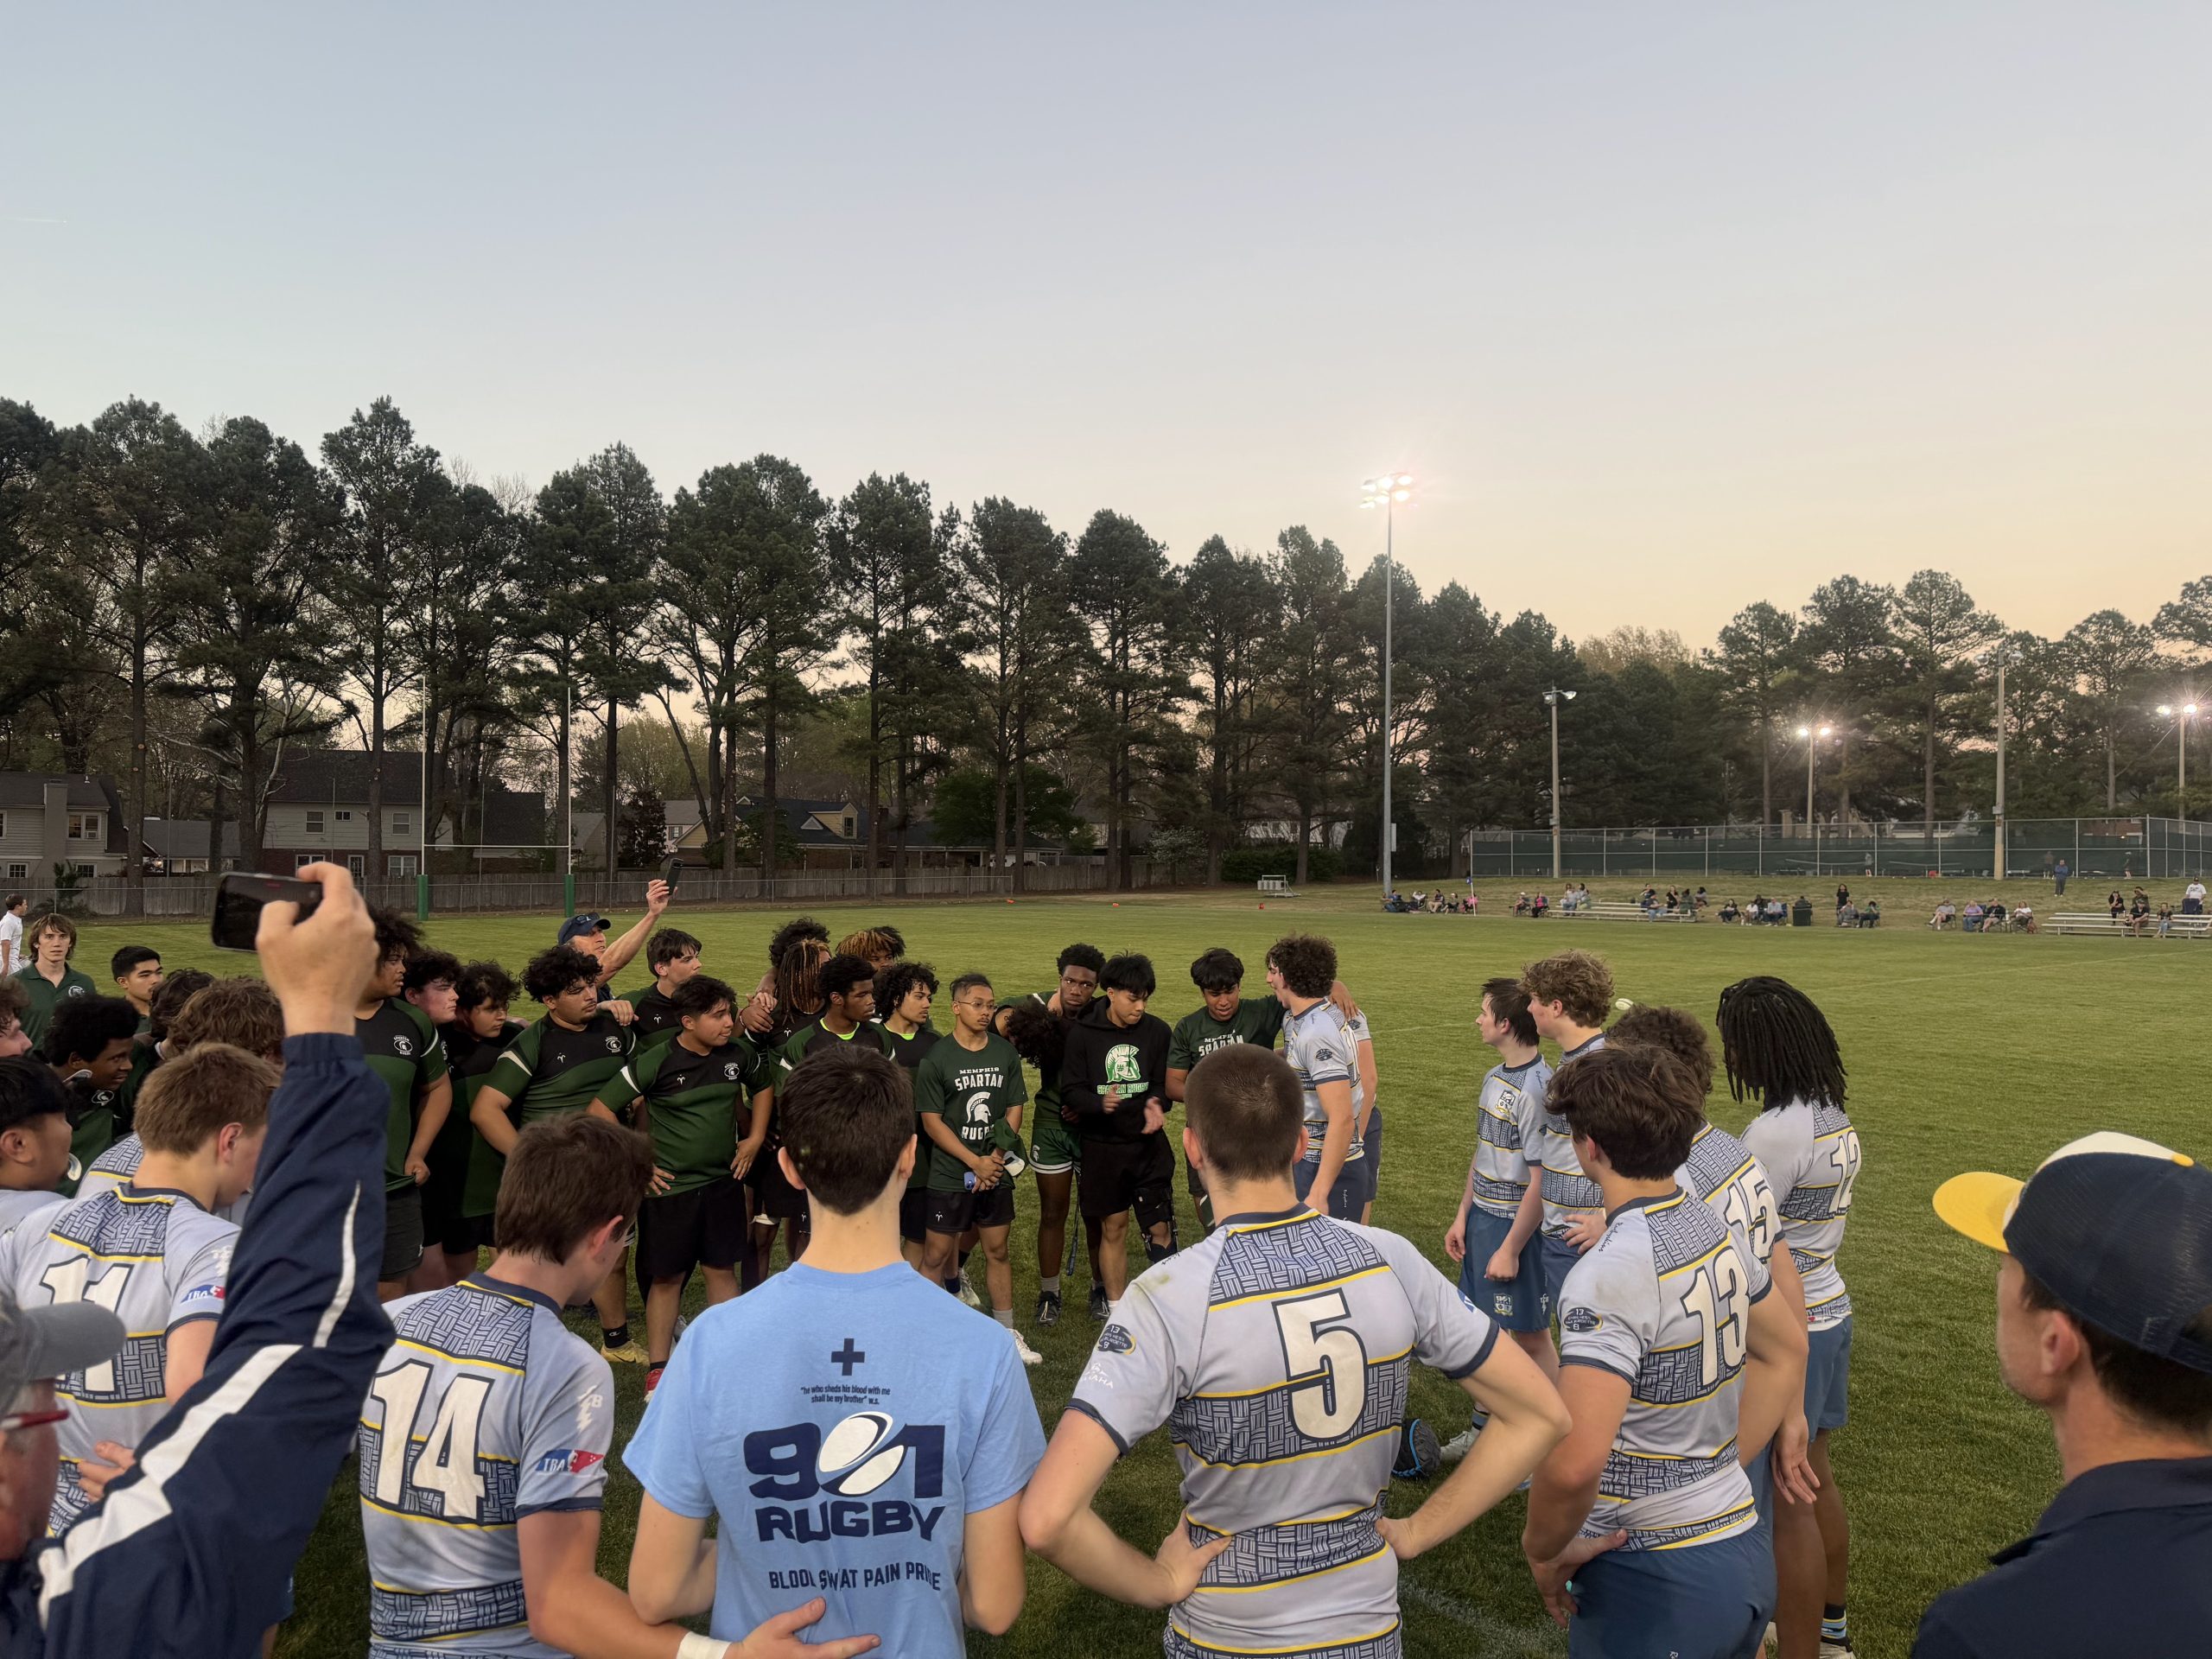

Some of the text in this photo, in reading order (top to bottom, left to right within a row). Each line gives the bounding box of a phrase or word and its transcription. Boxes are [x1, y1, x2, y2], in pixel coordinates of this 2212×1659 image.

[955, 1073, 1004, 1091] SPARTAN
[1830, 1130, 1862, 1215] 12
[1724, 1164, 1780, 1260] 15
[1110, 1325, 1121, 1333] 13
[1680, 1246, 1750, 1388] 13
[810, 1384, 824, 1393] who
[824, 1384, 842, 1393] sheds
[842, 1384, 851, 1393] his
[851, 1384, 868, 1394] blood
[868, 1386, 880, 1395] with
[1271, 1288, 1369, 1440] 5
[810, 1394, 825, 1403] shall
[371, 1358, 496, 1523] 14
[744, 1411, 946, 1502] 901
[755, 1500, 946, 1544] RUGBY
[818, 1567, 858, 1592] SWAT
[864, 1562, 900, 1587] PAIN
